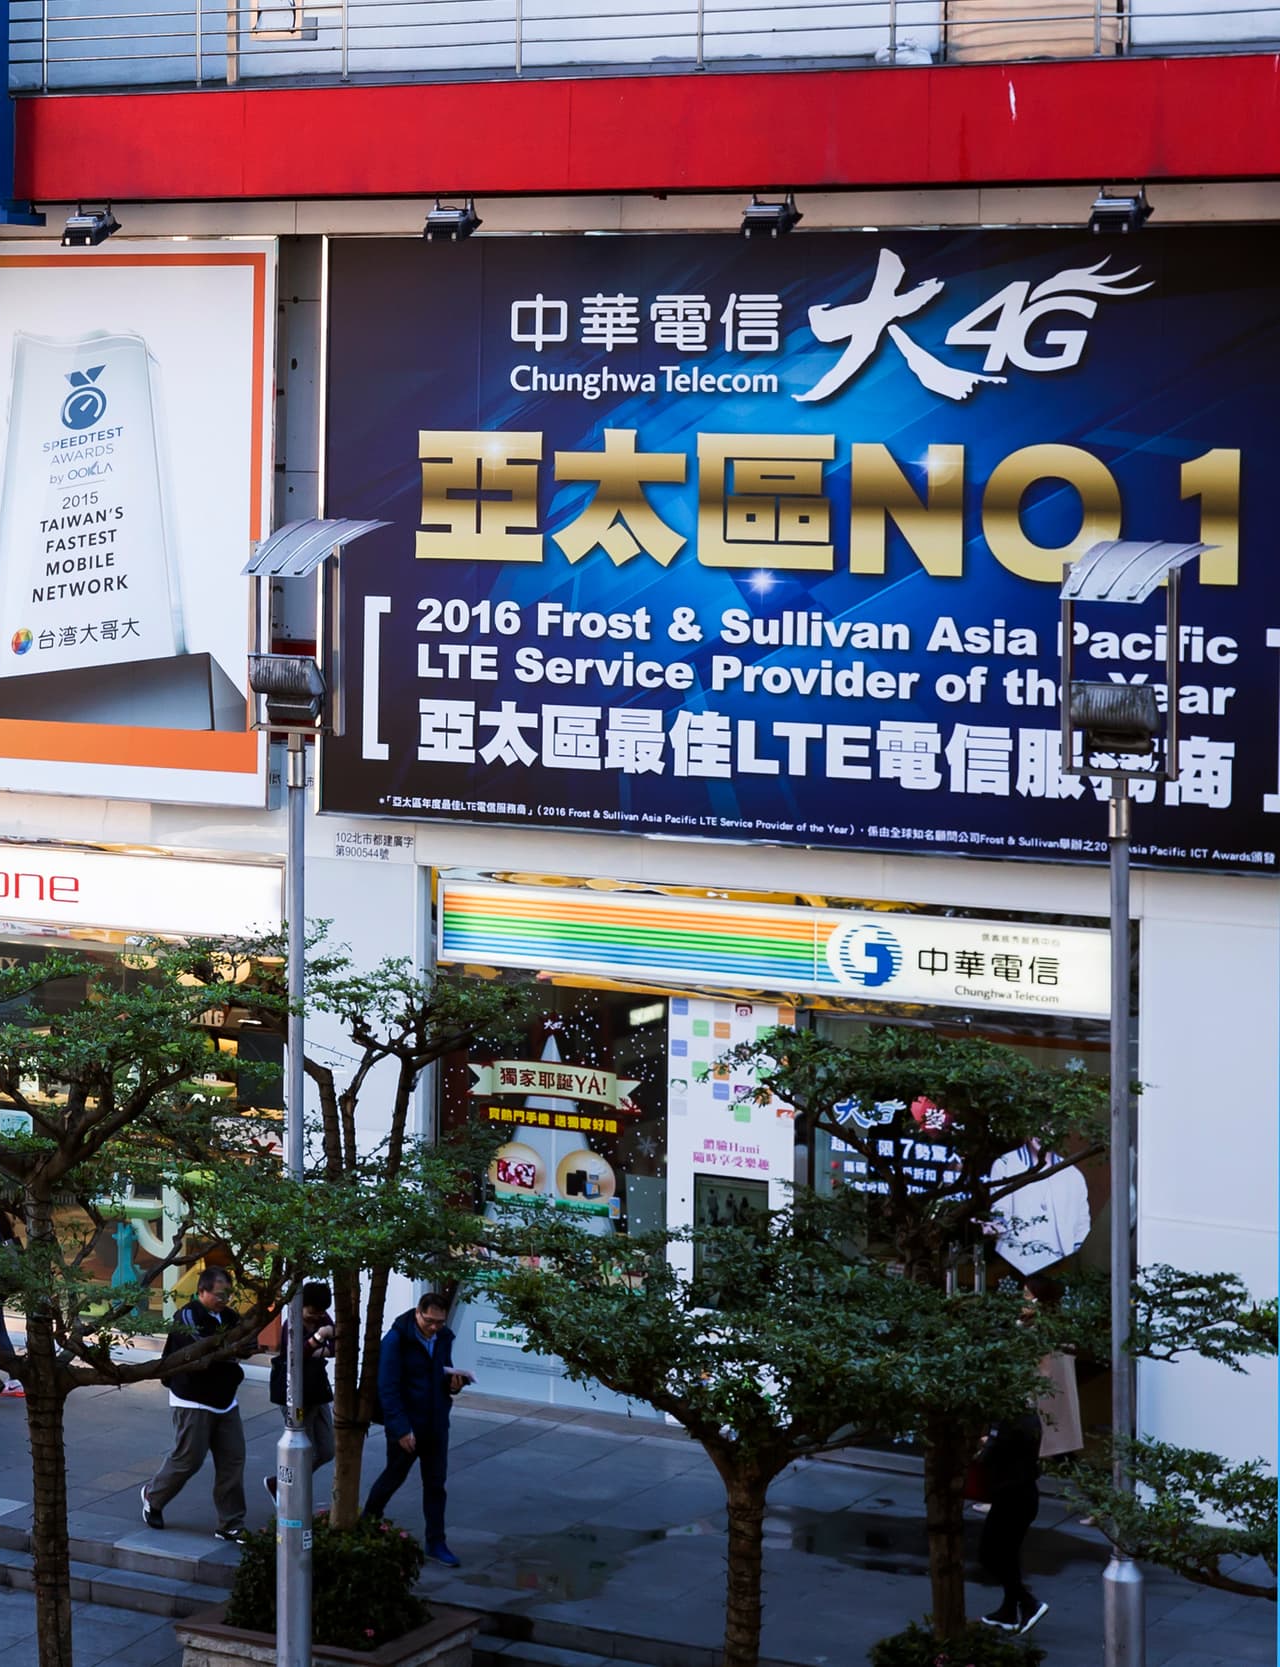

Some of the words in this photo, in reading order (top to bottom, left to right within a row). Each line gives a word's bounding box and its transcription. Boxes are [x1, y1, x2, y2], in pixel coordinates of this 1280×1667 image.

[510, 292, 780, 354] 中華電信
[790, 248, 1154, 402] 大4G
[510, 365, 658, 401] Chunghwa
[664, 365, 779, 395] Telecom
[42, 427, 124, 453] SPEEDTEST
[50, 443, 115, 465] AWARDS
[49, 473, 65, 485] by
[67, 461, 113, 481] OOKLA
[62, 491, 99, 510] 2015
[415, 428, 1241, 588] 亞太區NO1
[45, 529, 118, 554] FASTEST
[45, 552, 116, 577] MOBILE
[32, 574, 128, 603] NETWORK
[38, 617, 141, 650] 台湾大哥大
[416, 600, 521, 636] 2016
[539, 603, 651, 641] Frost
[672, 607, 702, 644] &
[721, 609, 909, 651] Sullivan
[928, 616, 1038, 656] Asia
[1057, 621, 1239, 664] Pacific
[417, 646, 498, 680] LTE
[515, 649, 693, 689] Service
[713, 656, 919, 700] Provider
[937, 664, 990, 702] of
[1002, 666, 1065, 708] th
[336, 832, 414, 848] 102北市都建廣字
[569, 808, 591, 818] Frost
[593, 809, 601, 819] &
[603, 810, 639, 822] Sullivan
[642, 813, 663, 824] Asia
[665, 814, 696, 826] Pacific
[699, 816, 717, 826] LTE
[720, 817, 753, 828] Service
[756, 820, 793, 831] Provider
[796, 821, 807, 832] of
[809, 823, 824, 833] the
[1150, 845, 1186, 858] Pacific
[1190, 848, 1208, 859] ICT
[336, 845, 390, 860] 第900544號
[918, 947, 1060, 985] 中華電信
[954, 985, 1012, 1001] Chunghwa
[1013, 990, 1059, 1003] Telecom
